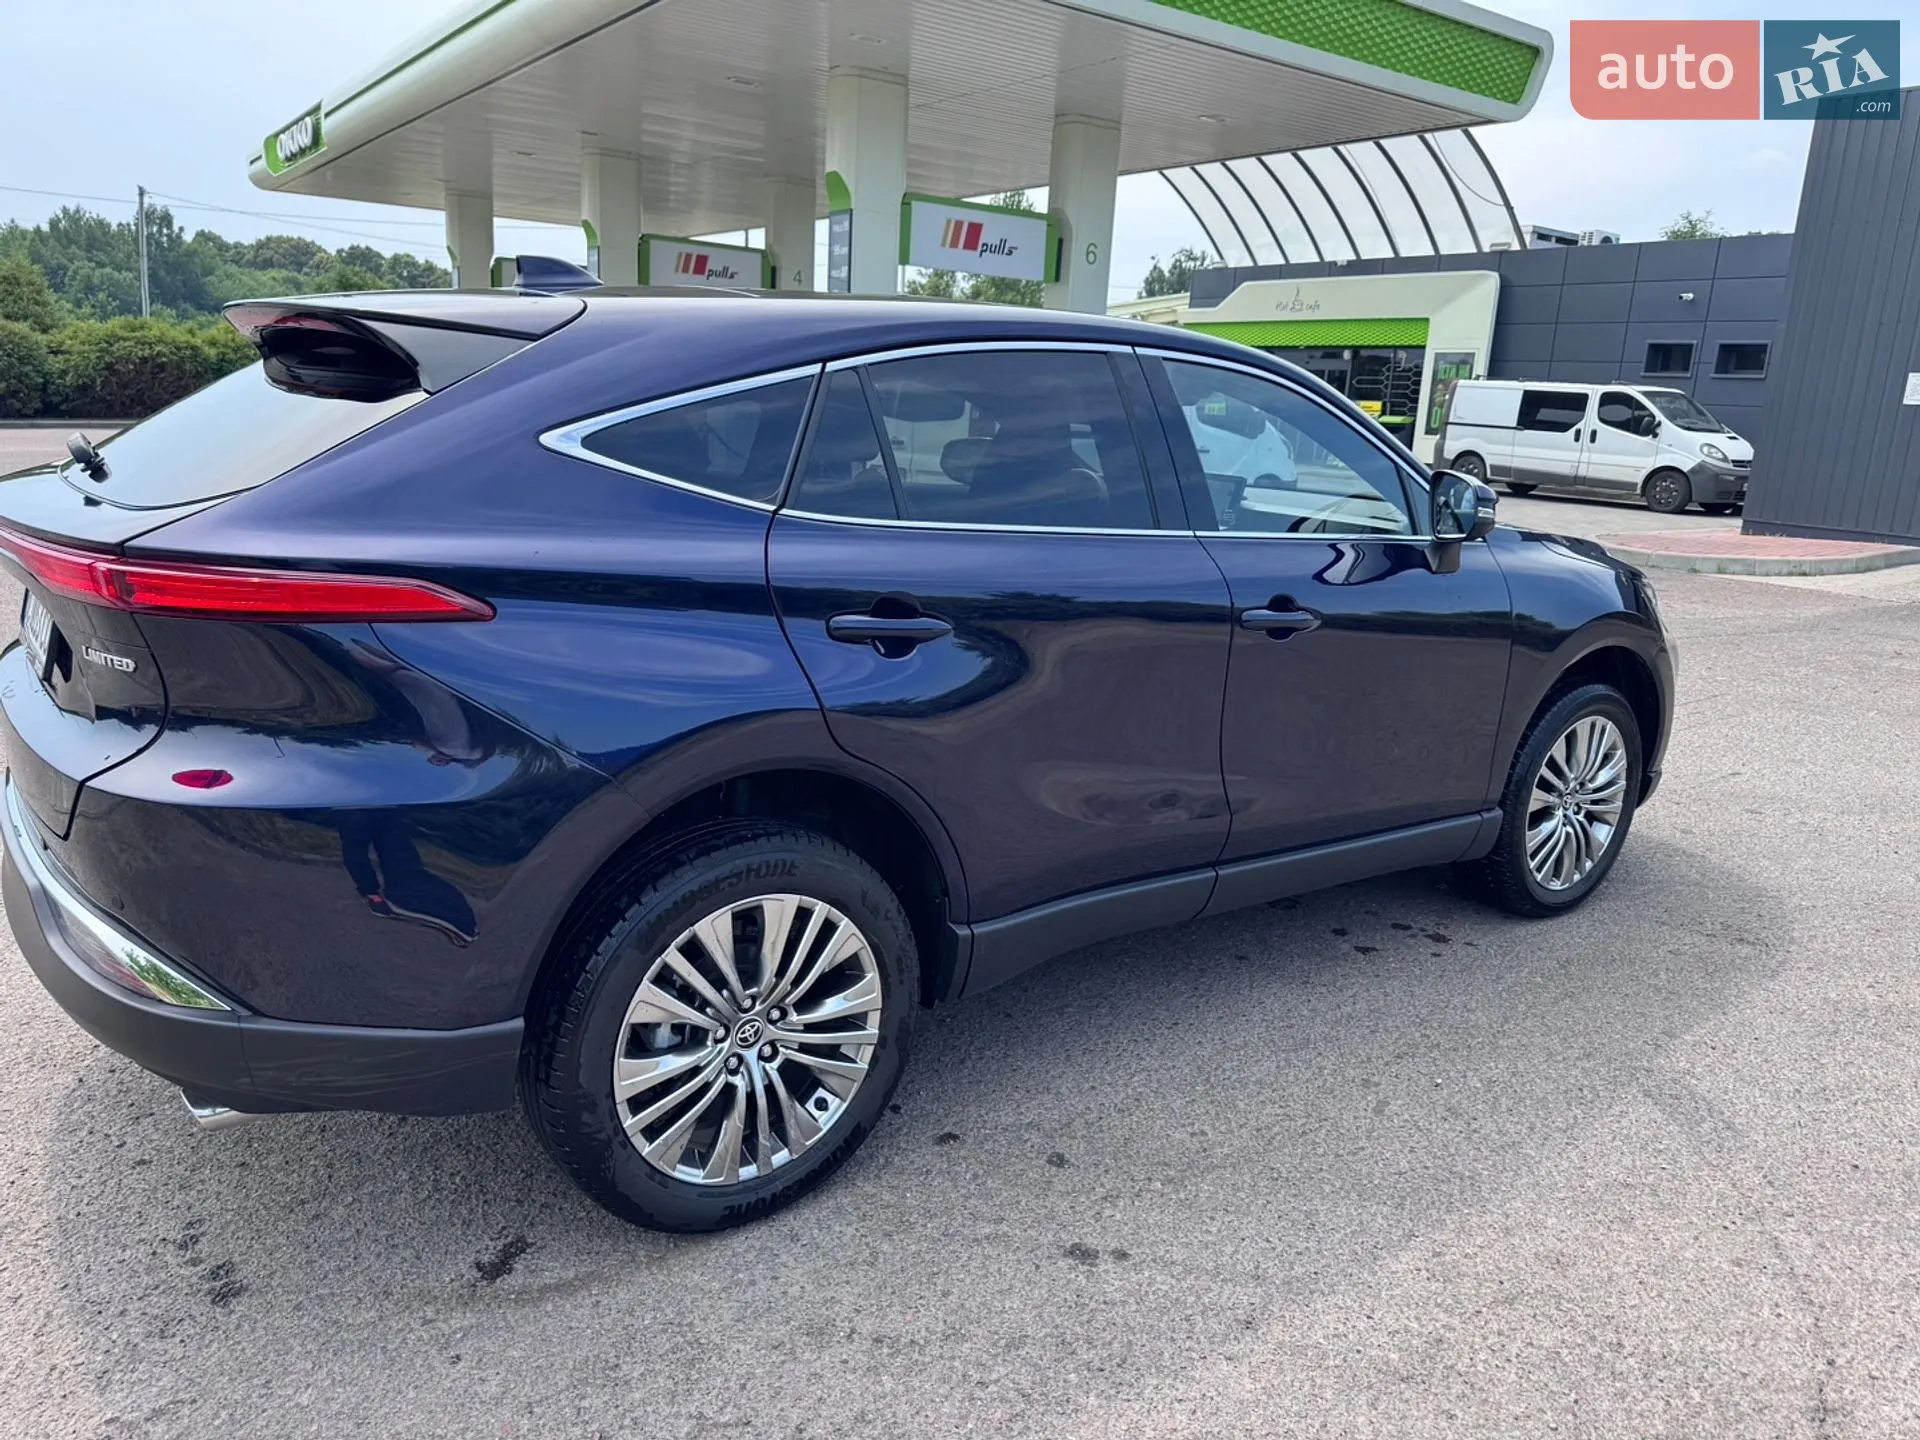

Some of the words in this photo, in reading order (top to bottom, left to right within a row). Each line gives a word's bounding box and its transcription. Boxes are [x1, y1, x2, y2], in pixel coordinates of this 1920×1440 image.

[978, 238, 1018, 258] pulls
[1085, 242, 1098, 265] 6
[706, 265, 739, 281] pulls
[792, 269, 802, 285] 4
[82, 645, 137, 673] LIMITED
